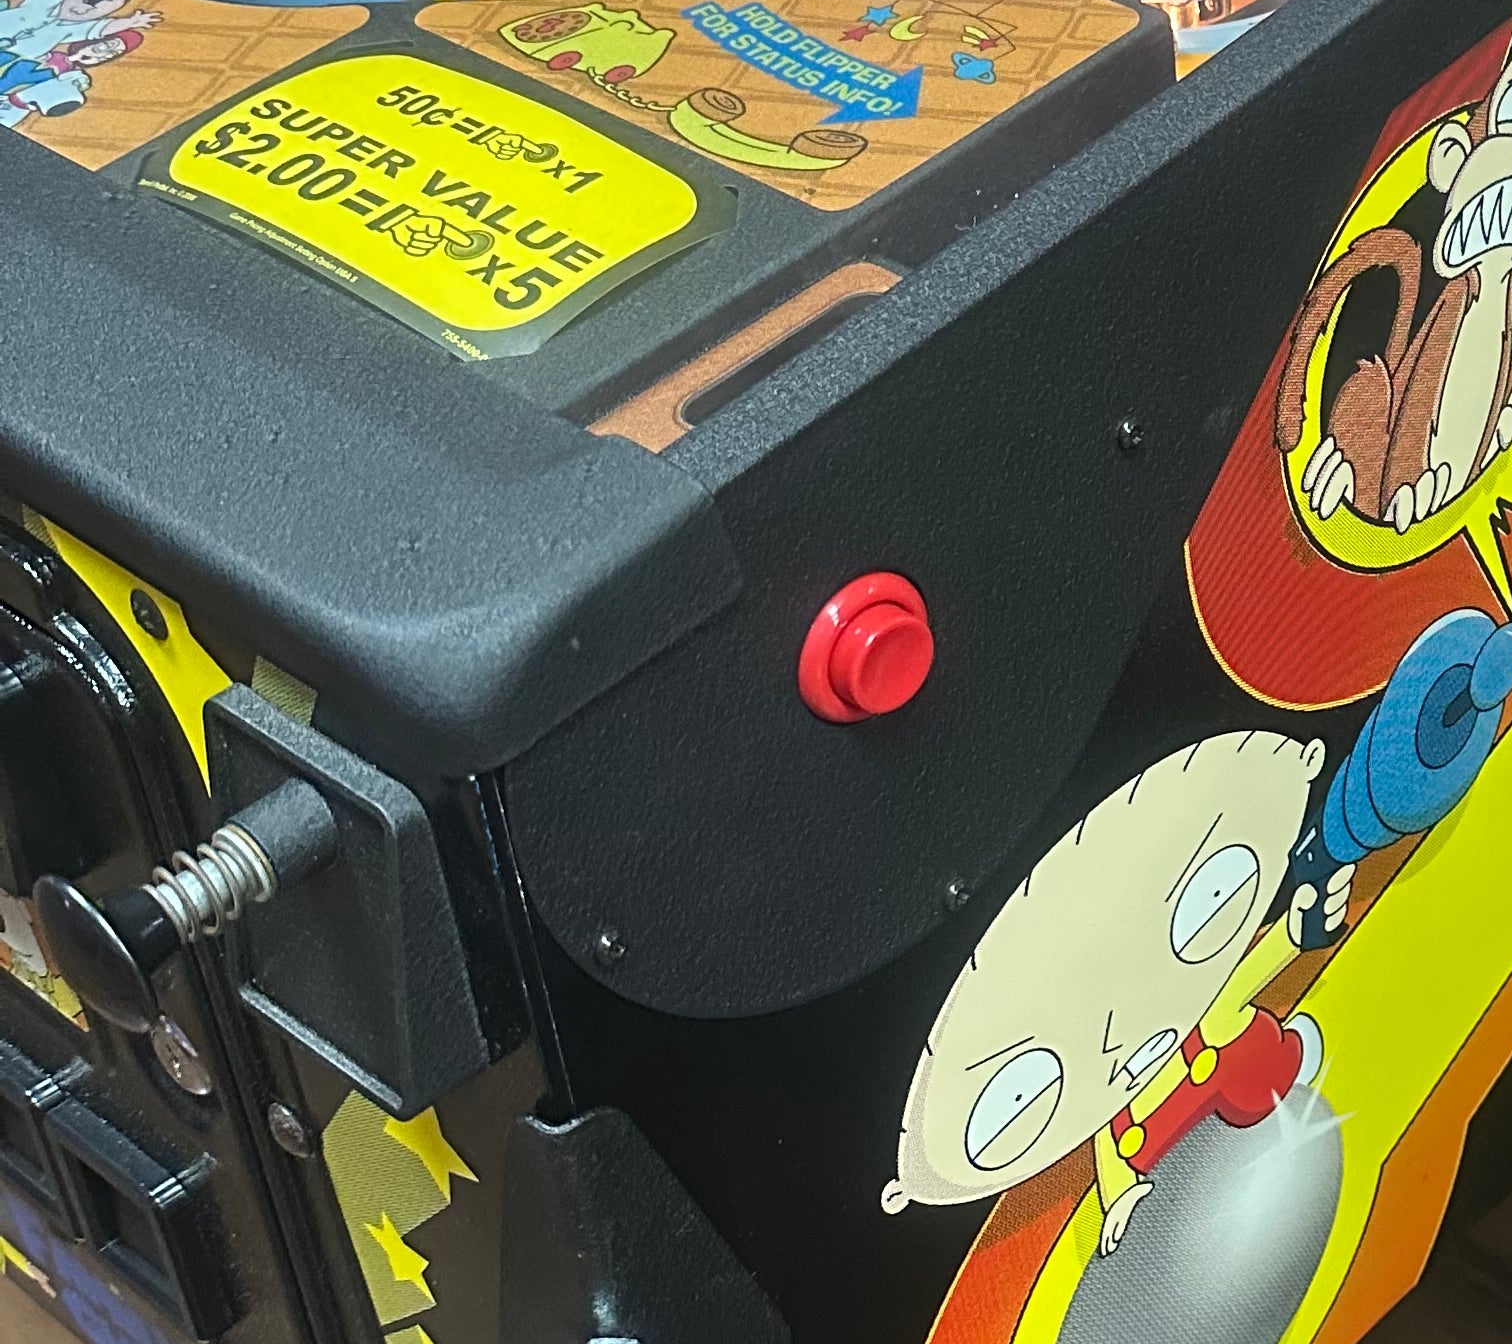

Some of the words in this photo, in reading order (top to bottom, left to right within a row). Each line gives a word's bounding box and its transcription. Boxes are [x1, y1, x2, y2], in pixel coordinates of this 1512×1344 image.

[689, 3, 739, 39] FOR
[730, 33, 826, 88] STATUS
[819, 78, 904, 117] INFO!
[735, 4, 798, 45] HOLD
[790, 38, 898, 90] FLIPPER
[250, 98, 416, 180] SUPER
[421, 169, 606, 275] VALUE
[542, 158, 605, 194] x1
[466, 253, 563, 312] x5
